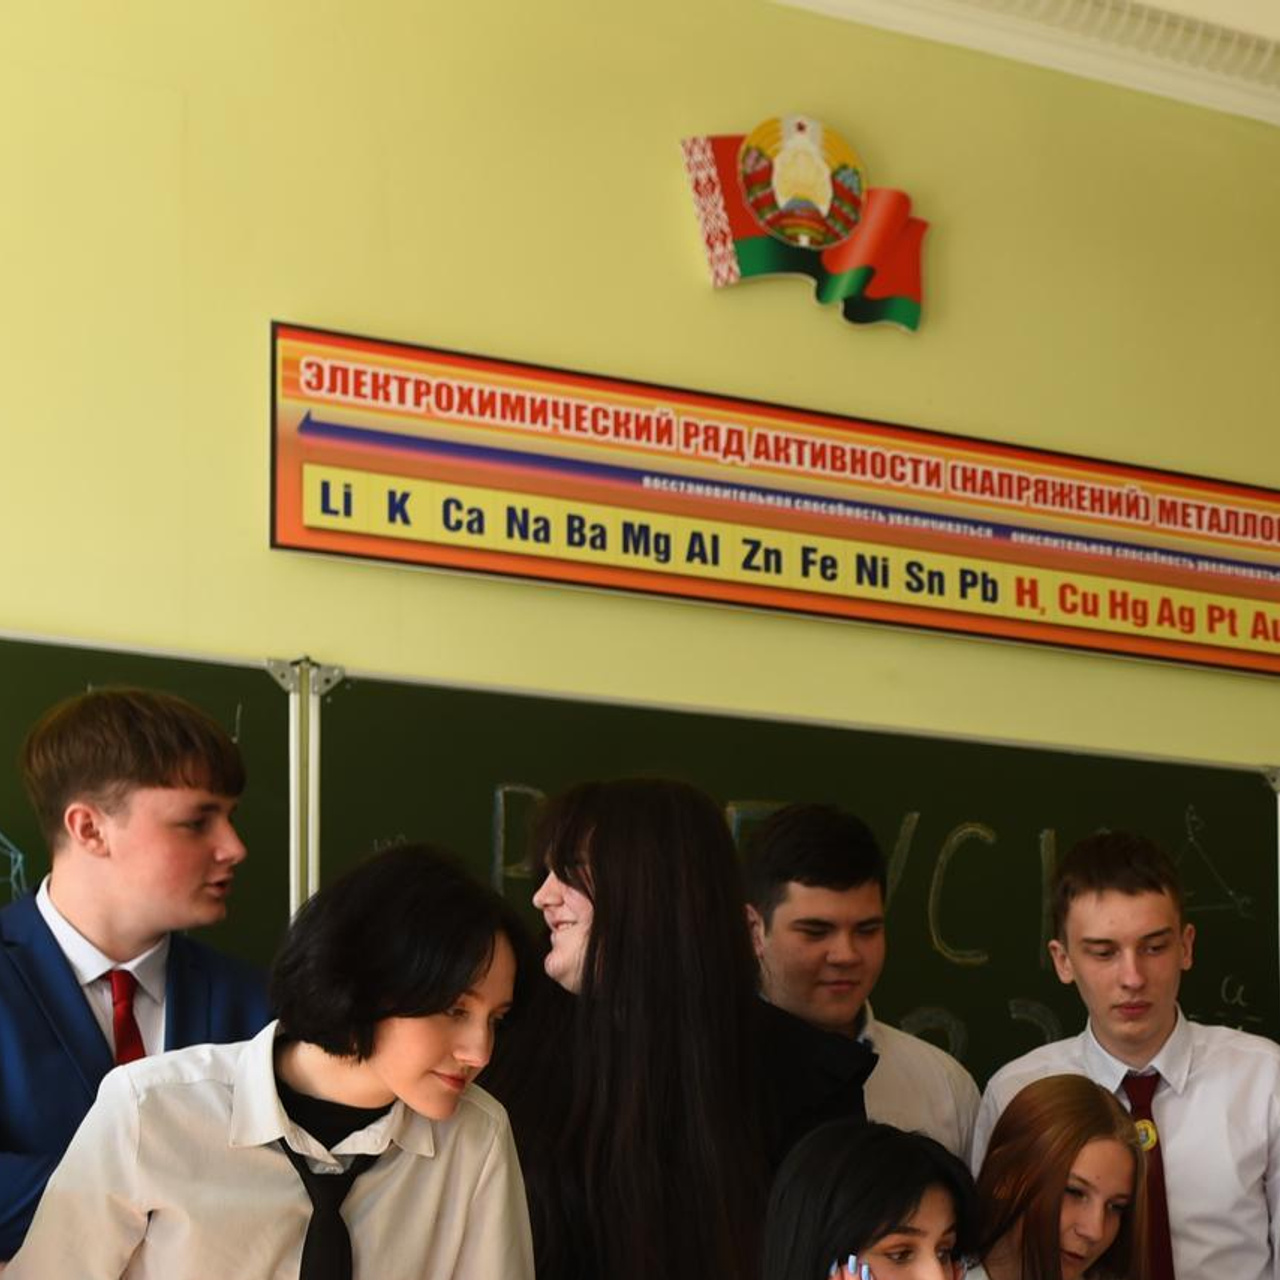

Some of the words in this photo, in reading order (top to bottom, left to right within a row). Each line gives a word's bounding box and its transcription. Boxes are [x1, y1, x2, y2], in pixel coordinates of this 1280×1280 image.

[304, 360, 674, 446] ЭЛЕКТРОХИМИЧЕСКИЙ
[682, 420, 746, 462] РЯД
[752, 431, 942, 488] АКТИВНОСТИ
[321, 481, 351, 517] Li
[388, 490, 411, 525] K
[442, 498, 485, 535] Ca
[506, 506, 551, 544] Na
[566, 514, 607, 551] Ba
[622, 522, 671, 563] Mg
[686, 532, 719, 566] Al
[741, 539, 783, 575] Zn
[801, 546, 838, 581] Fe
[856, 554, 889, 588] Ni
[905, 561, 945, 597] Sn
[959, 569, 999, 603] Pb
[1058, 583, 1099, 618] Cu
[1109, 590, 1149, 628] Hg
[1157, 597, 1196, 635] Ag
[1207, 604, 1238, 637] Pt
